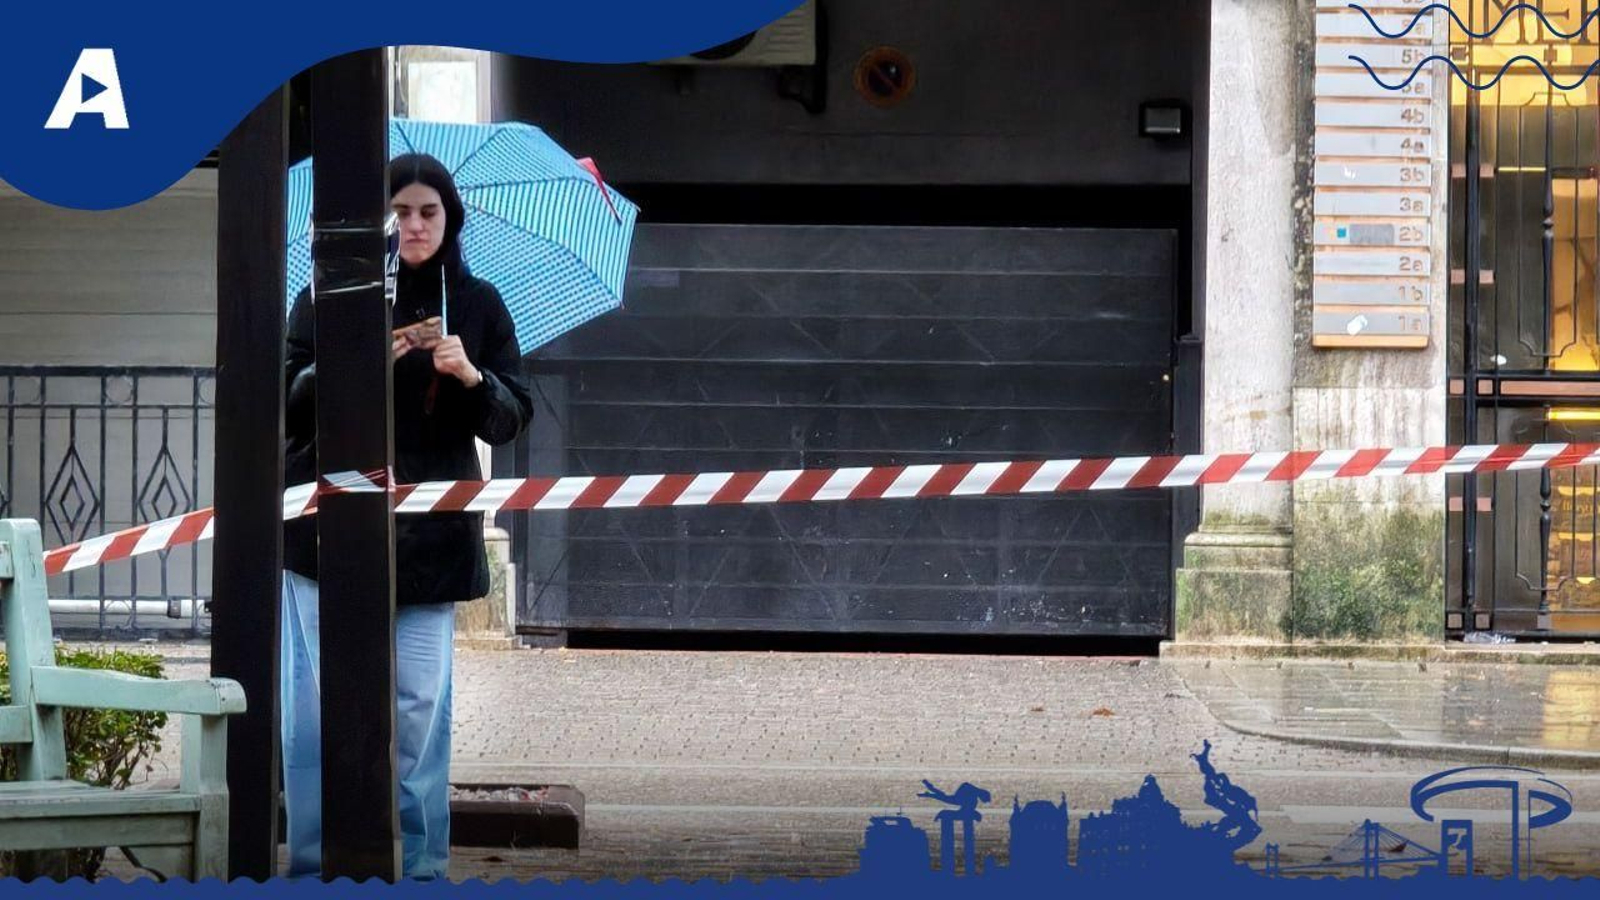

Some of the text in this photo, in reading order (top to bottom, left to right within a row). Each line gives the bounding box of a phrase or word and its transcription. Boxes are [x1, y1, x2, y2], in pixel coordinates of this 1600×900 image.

[1401, 108, 1424, 124] 4b
[1400, 167, 1424, 181] 3b
[1400, 197, 1423, 211] 3a
[1399, 226, 1423, 241] 2b
[1399, 256, 1423, 271] 2a
[1399, 286, 1423, 301] 1b
